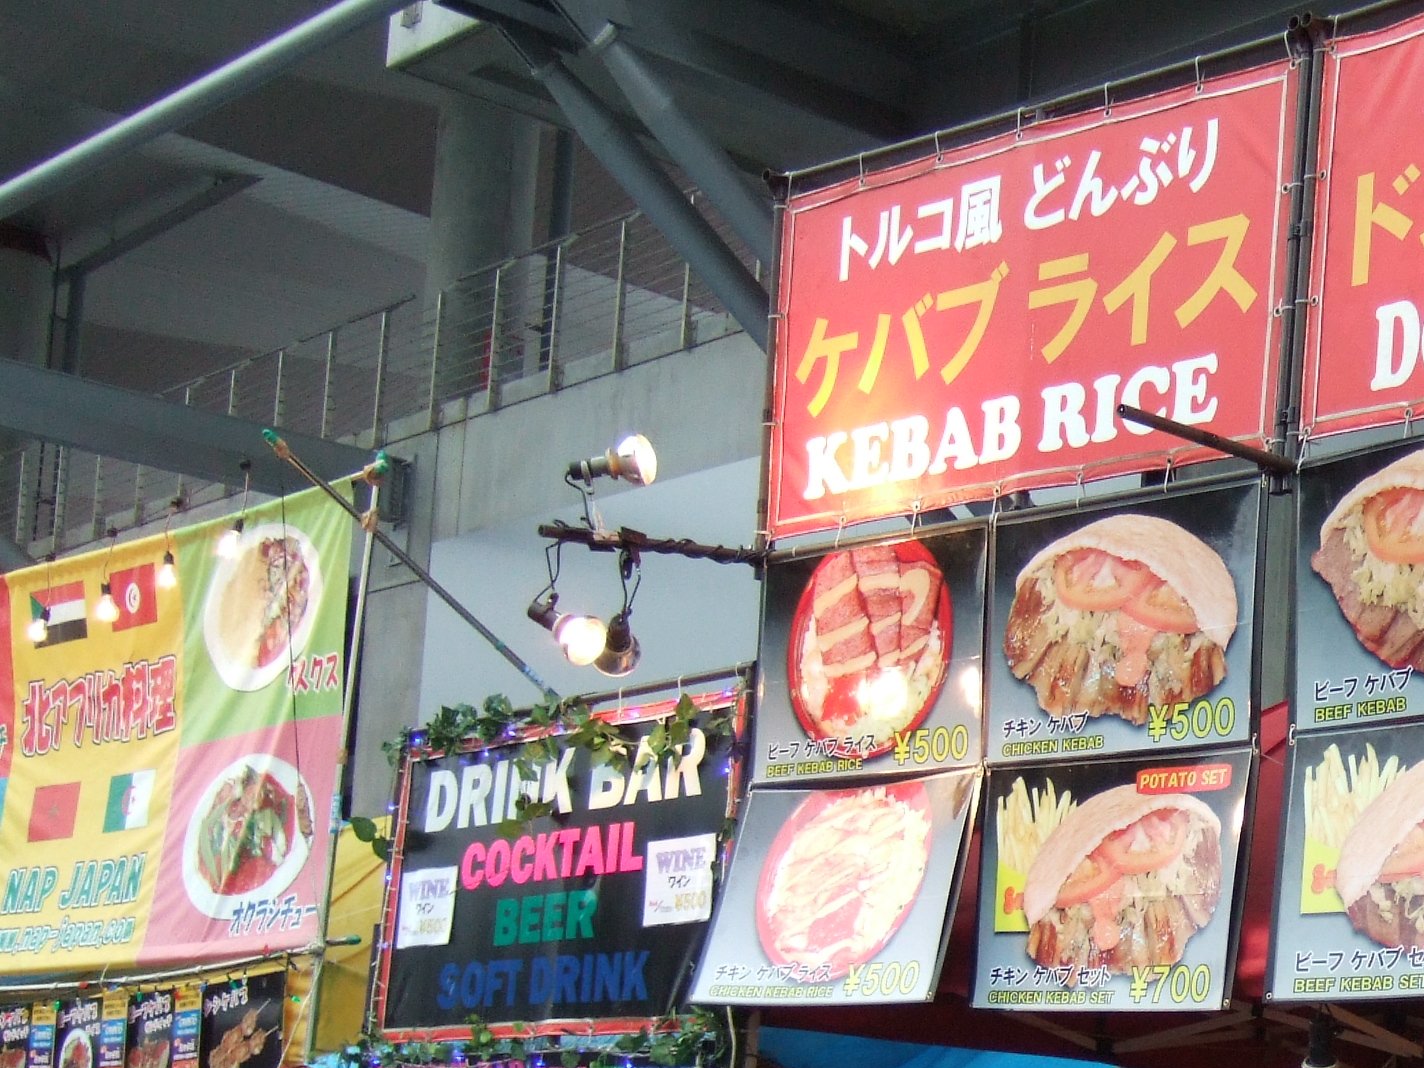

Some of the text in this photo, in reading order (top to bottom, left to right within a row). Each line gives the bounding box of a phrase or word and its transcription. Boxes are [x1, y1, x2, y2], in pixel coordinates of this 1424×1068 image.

[839, 118, 1219, 282] トルコ風 どんぶり
[795, 213, 1258, 417] ケバブ ライス
[803, 353, 1219, 501] KEBAB RICE
[1314, 666, 1414, 702] ビーフ ケバブ
[21, 654, 177, 758] 北アフリカ料理
[1147, 697, 1236, 742] ¥500
[1314, 697, 1407, 724] BEEF KEBAB
[1002, 711, 1090, 739] チキン ケバブ
[767, 741, 799, 760] ビーフ
[844, 733, 877, 753] ライス
[893, 725, 969, 766] ¥500
[1002, 736, 1104, 757] CHICKEN KEBAB
[424, 727, 706, 833] DRINK BAR
[766, 757, 863, 778] BEEF KEBAB RICE
[1140, 768, 1228, 790] POTATO SET
[461, 821, 643, 890] COCKTAIL
[656, 847, 706, 874] WINE
[1, 852, 147, 915] NAP JAPAN
[409, 879, 450, 901] WINE
[494, 890, 598, 946] BEER
[714, 963, 753, 983] チキン
[799, 963, 832, 981] ライス
[989, 965, 1112, 987] チキン ケバブ セット
[1294, 951, 1345, 974] ビーフ
[1350, 946, 1404, 971] ケバブ
[437, 950, 650, 1010] SOFT DRINK
[709, 985, 834, 998] CHICKEN KEBAB RICE
[843, 960, 919, 996] ¥500
[1128, 963, 1211, 1004] ¥700
[1294, 977, 1336, 993] BEEF
[1340, 976, 1394, 992] KEBAB
[989, 990, 1115, 1004] CHICKEN KEBAB SET
